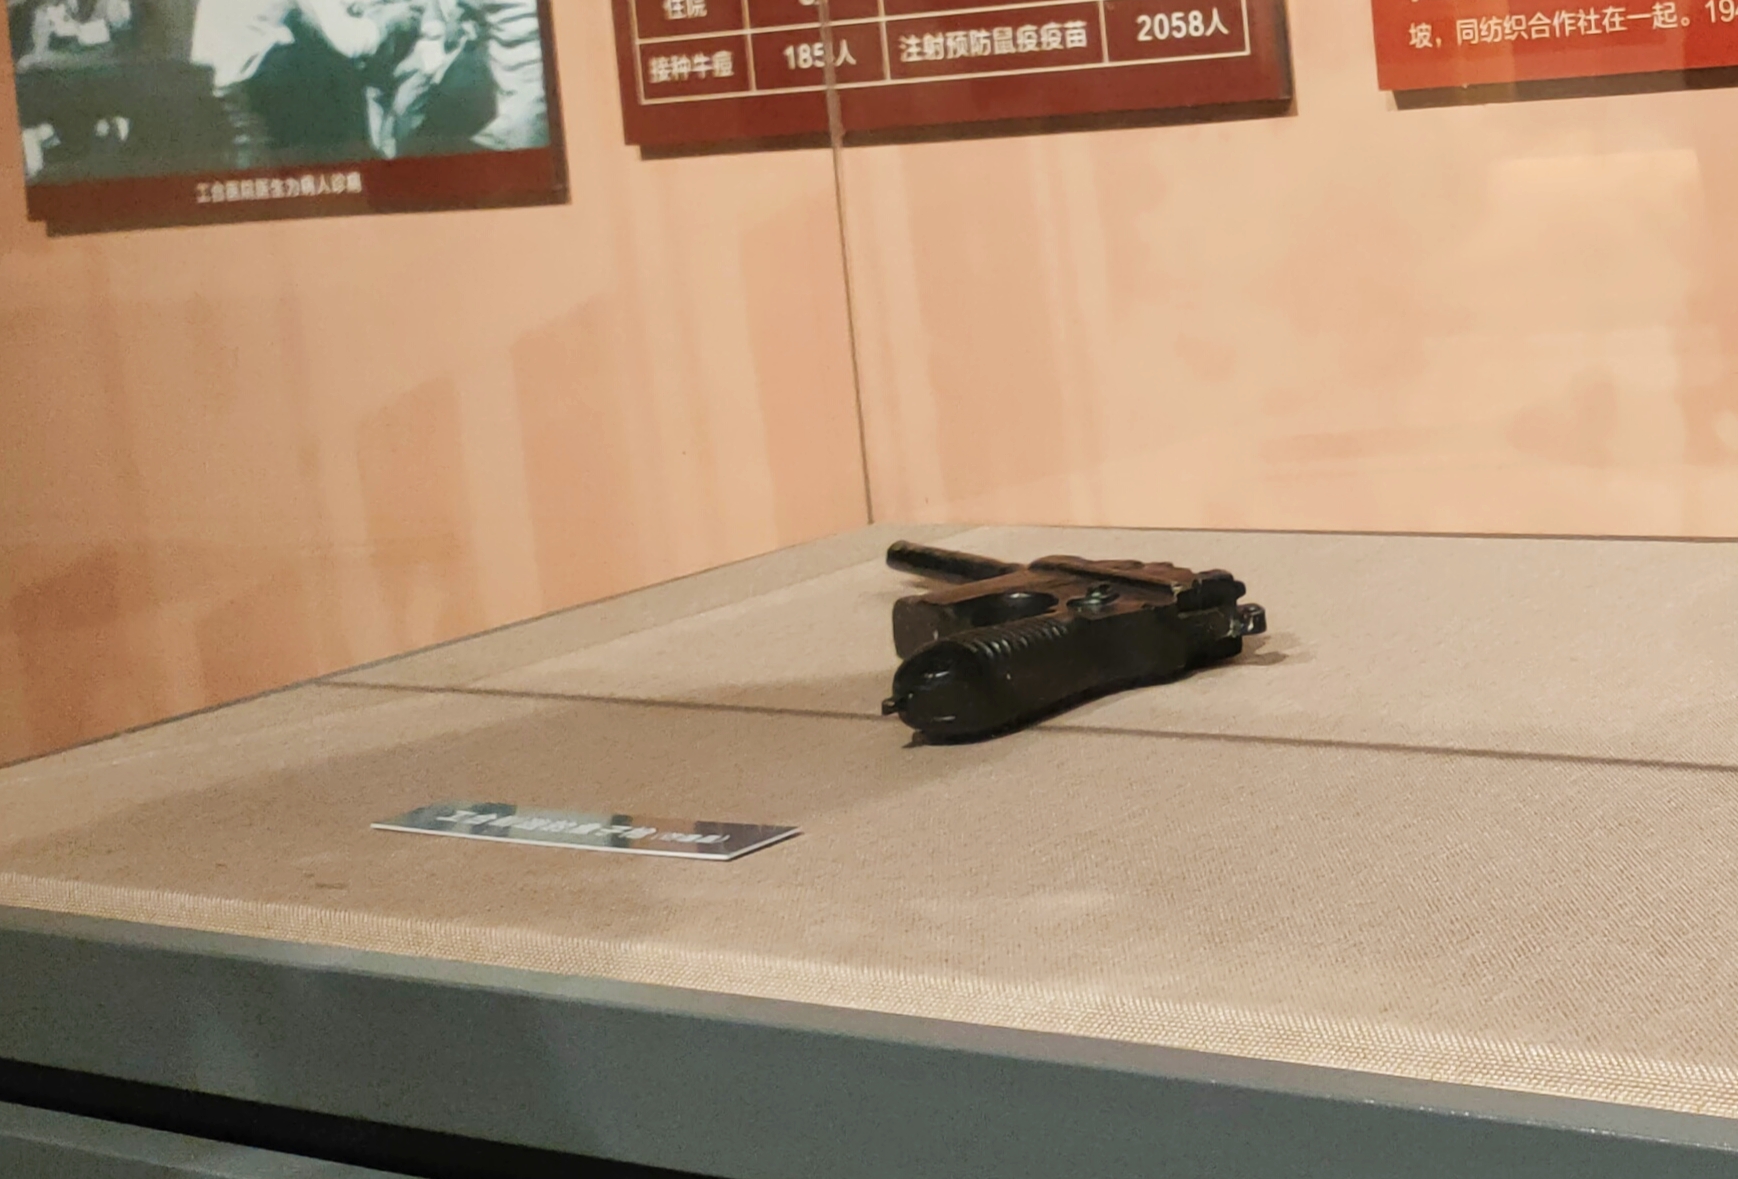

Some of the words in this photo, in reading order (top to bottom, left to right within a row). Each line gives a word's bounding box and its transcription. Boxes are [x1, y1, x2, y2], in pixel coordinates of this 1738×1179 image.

[898, 20, 1088, 63] 注射预防鼠疫疫苗
[1135, 6, 1230, 42] 2058人
